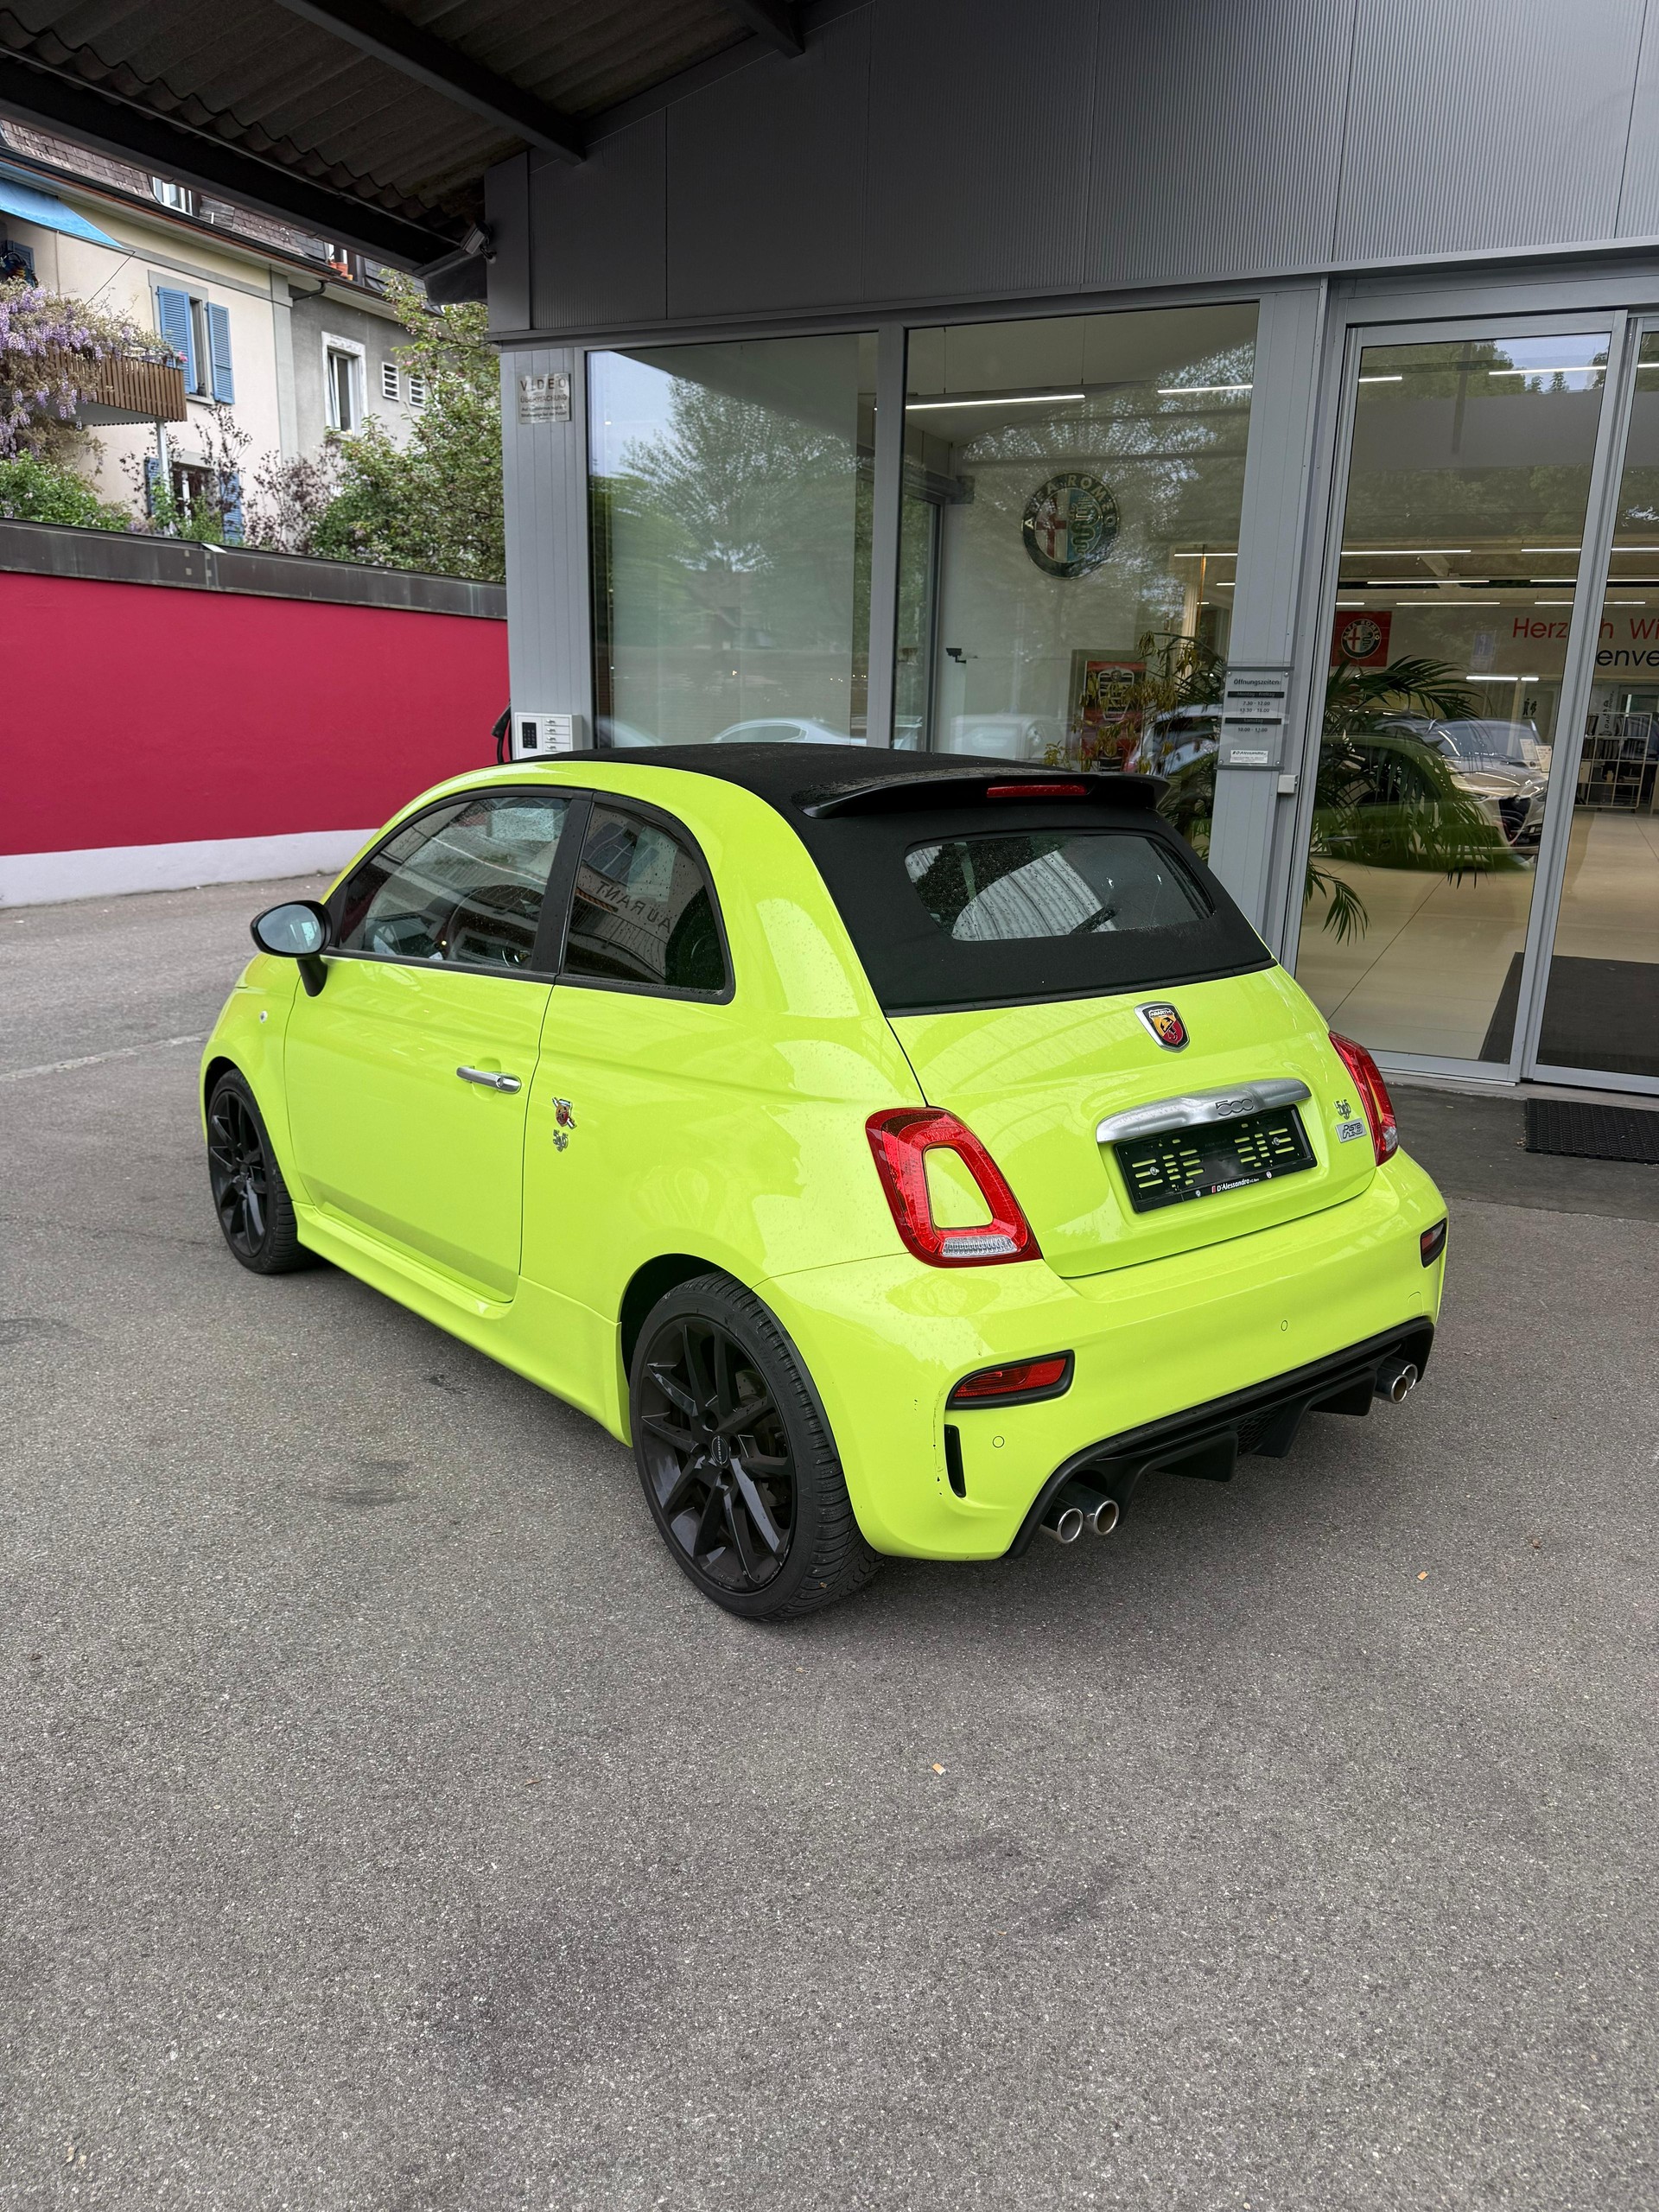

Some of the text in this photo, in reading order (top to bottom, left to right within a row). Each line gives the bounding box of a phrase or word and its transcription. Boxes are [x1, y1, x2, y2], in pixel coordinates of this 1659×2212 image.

[520, 378, 567, 391] VIDEO
[1068, 474, 1117, 527] ROMEO
[1596, 649, 1659, 667] enve
[1215, 1098, 1254, 1116] 500
